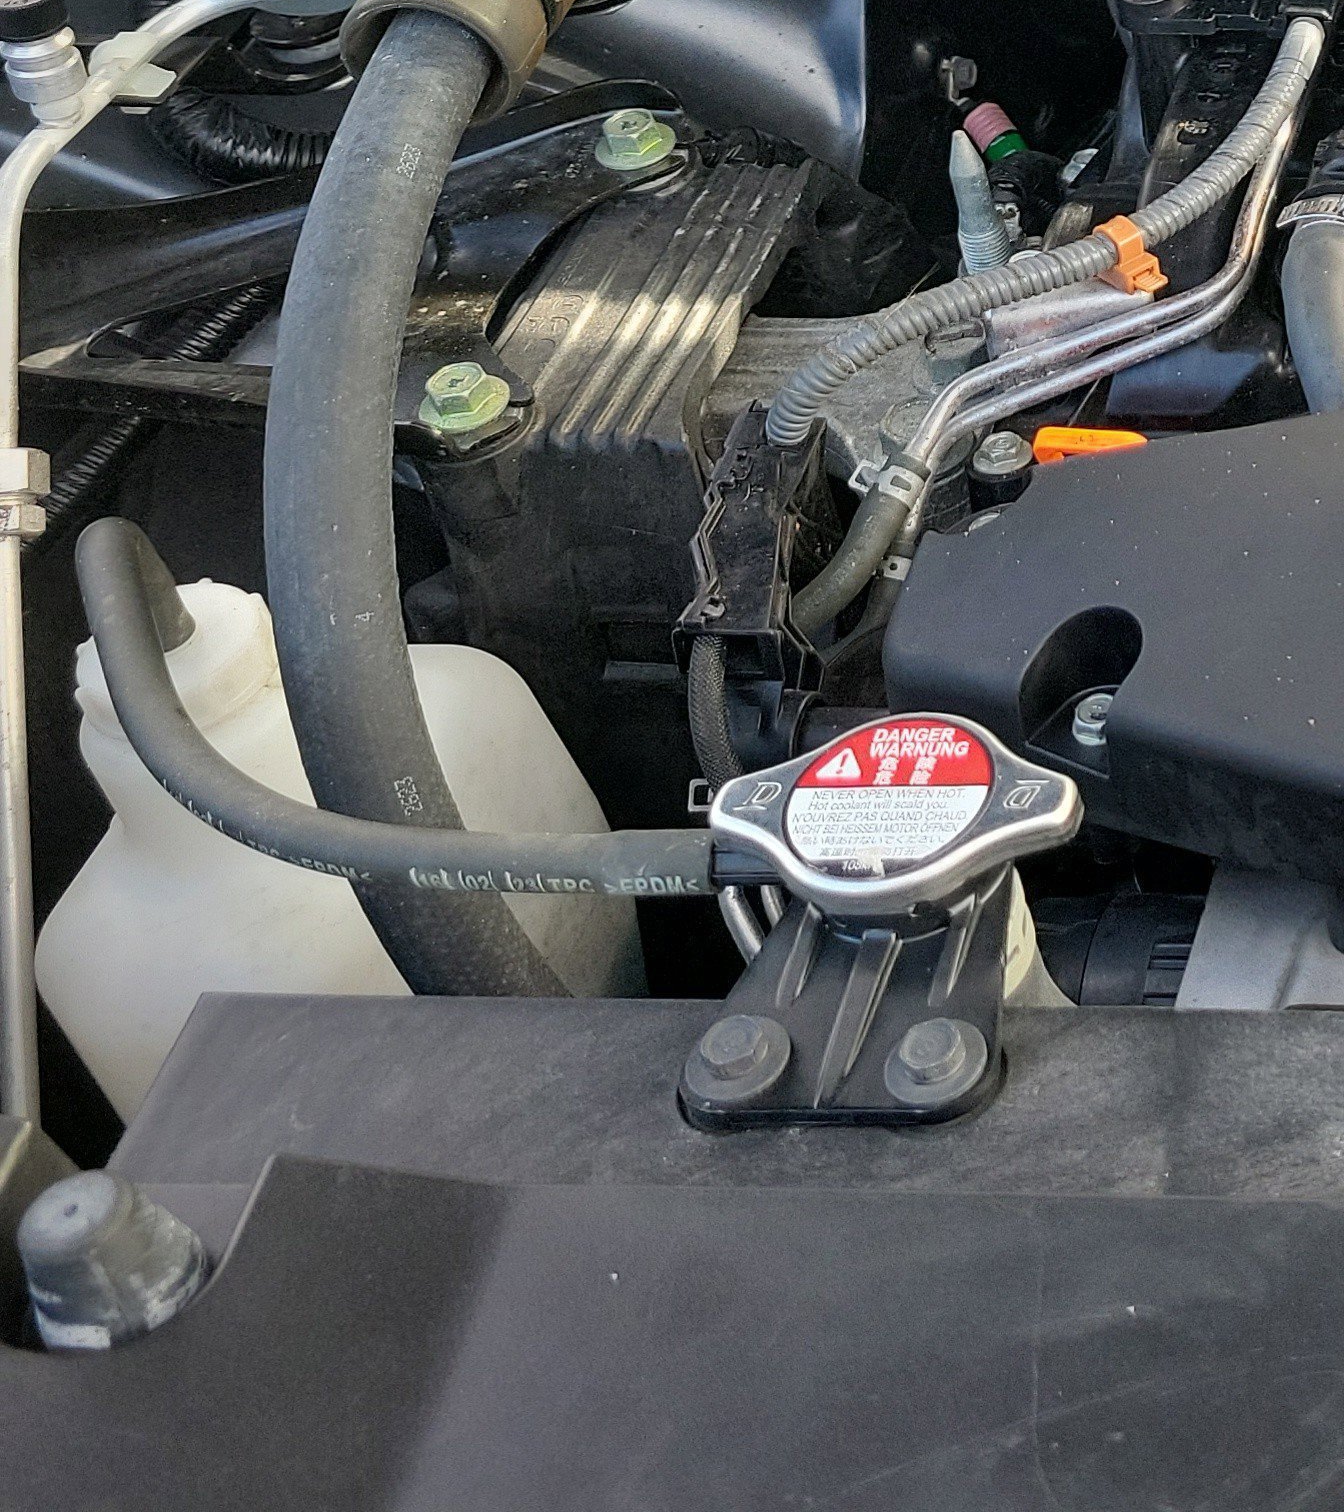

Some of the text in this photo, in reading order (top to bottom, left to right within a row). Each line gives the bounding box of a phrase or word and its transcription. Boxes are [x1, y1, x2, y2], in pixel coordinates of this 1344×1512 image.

[873, 727, 956, 742] DANGER
[869, 741, 970, 757] WARNUNG
[812, 789, 966, 801] NEVER OPEN WHEN HOT.
[807, 801, 828, 811] Hot
[830, 801, 871, 811] coolant
[873, 800, 893, 810] will
[895, 800, 923, 810] scald
[854, 812, 879, 822] PAS
[880, 812, 922, 822] QUAND
[793, 824, 822, 835] NICHT
[823, 824, 840, 834] BEI
[841, 824, 883, 834] HEISSEM
[884, 823, 918, 833] MOTOR
